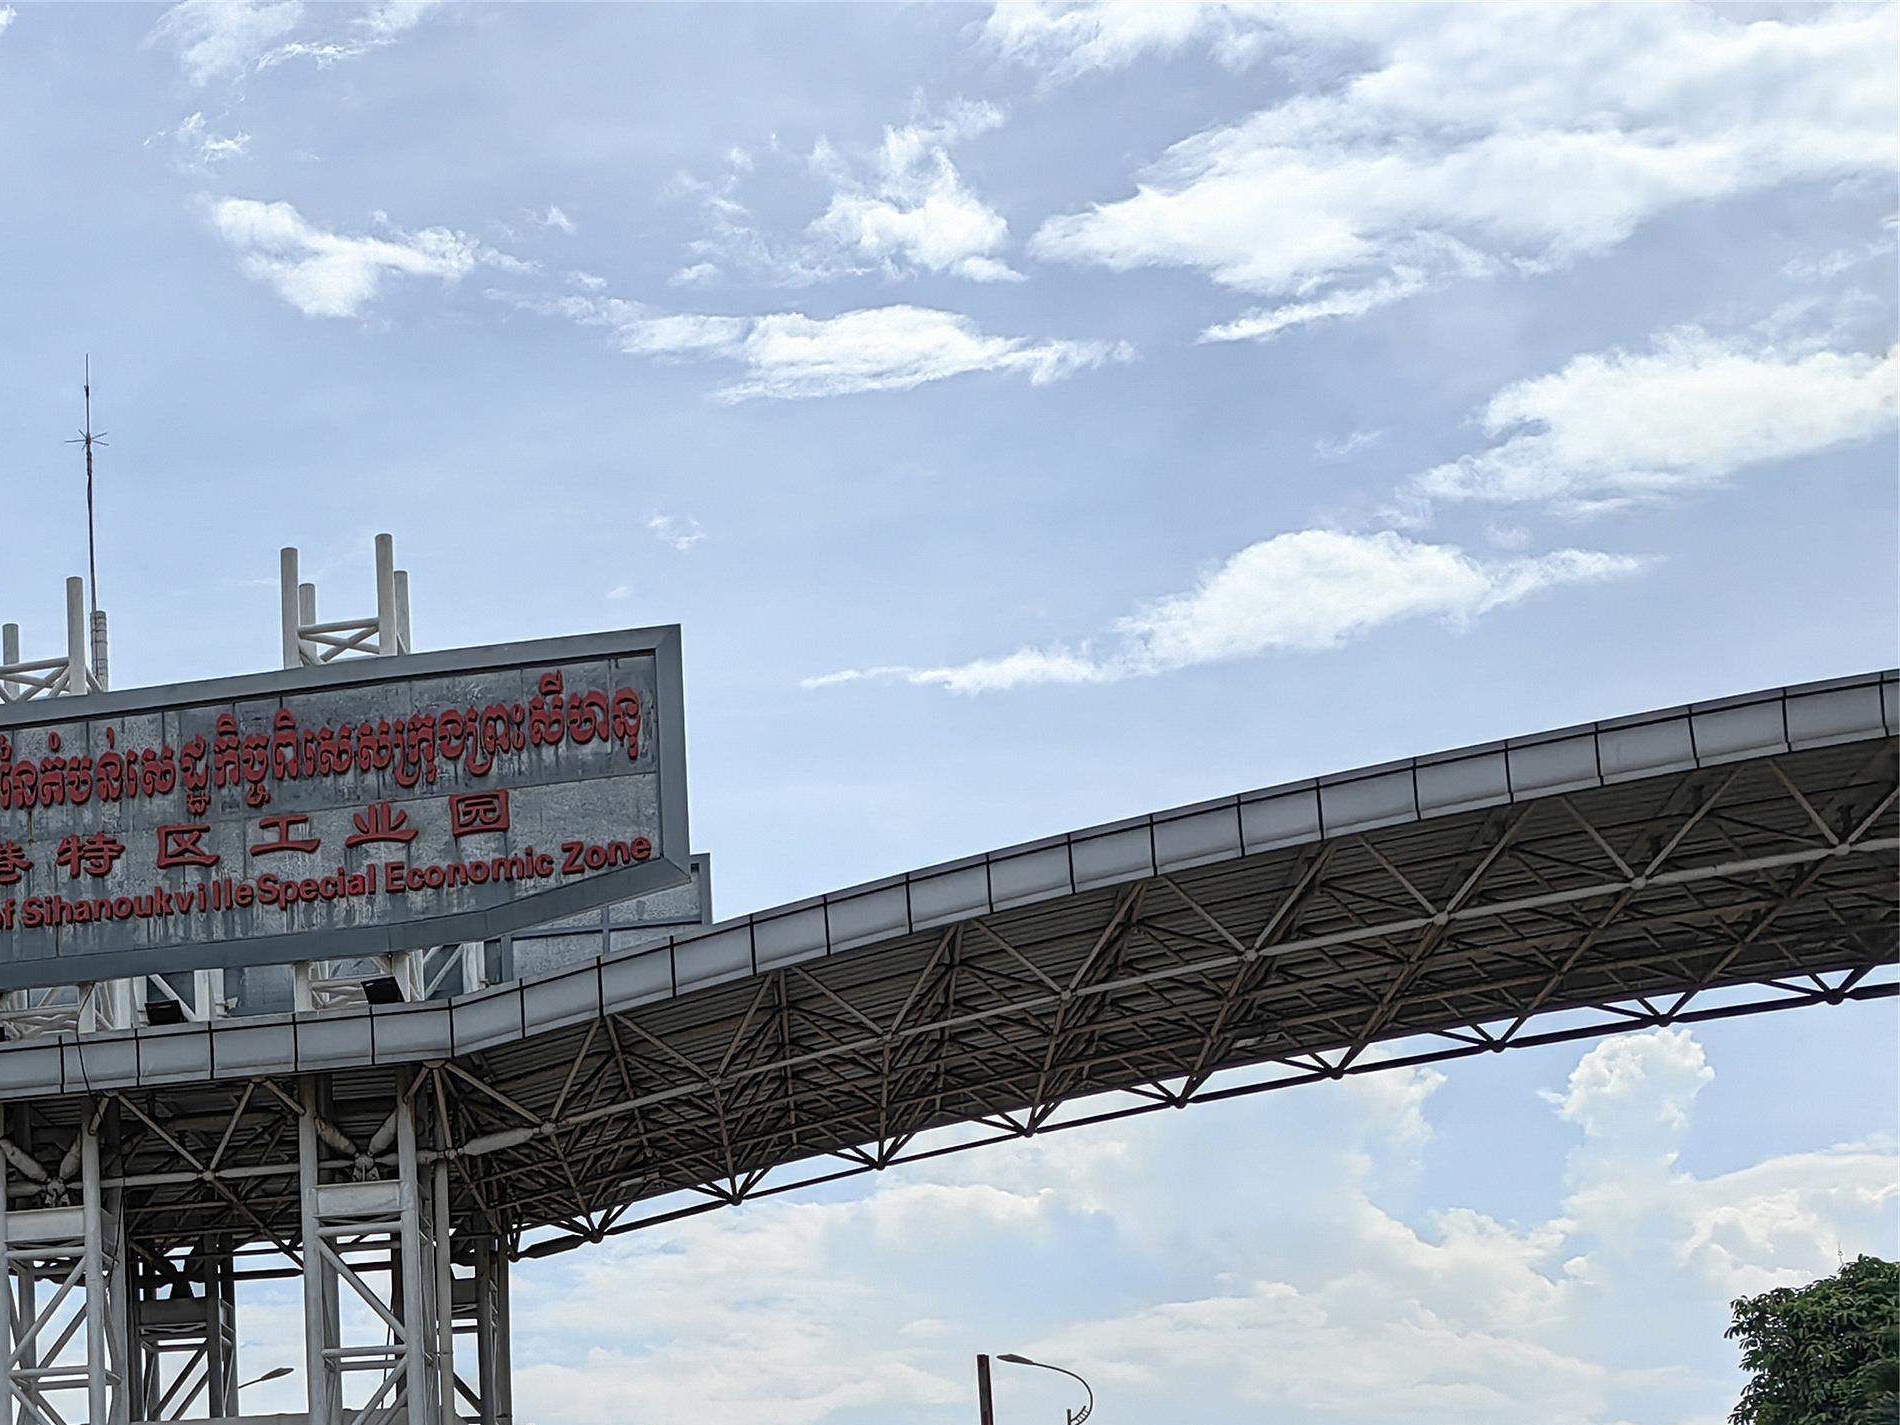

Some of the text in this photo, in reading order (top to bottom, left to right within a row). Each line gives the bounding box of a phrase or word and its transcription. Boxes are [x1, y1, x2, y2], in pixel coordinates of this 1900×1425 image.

[21, 878, 253, 929] Sihanoukville
[257, 863, 376, 910] Special
[385, 847, 555, 894] Economic
[561, 835, 652, 876] Zone
